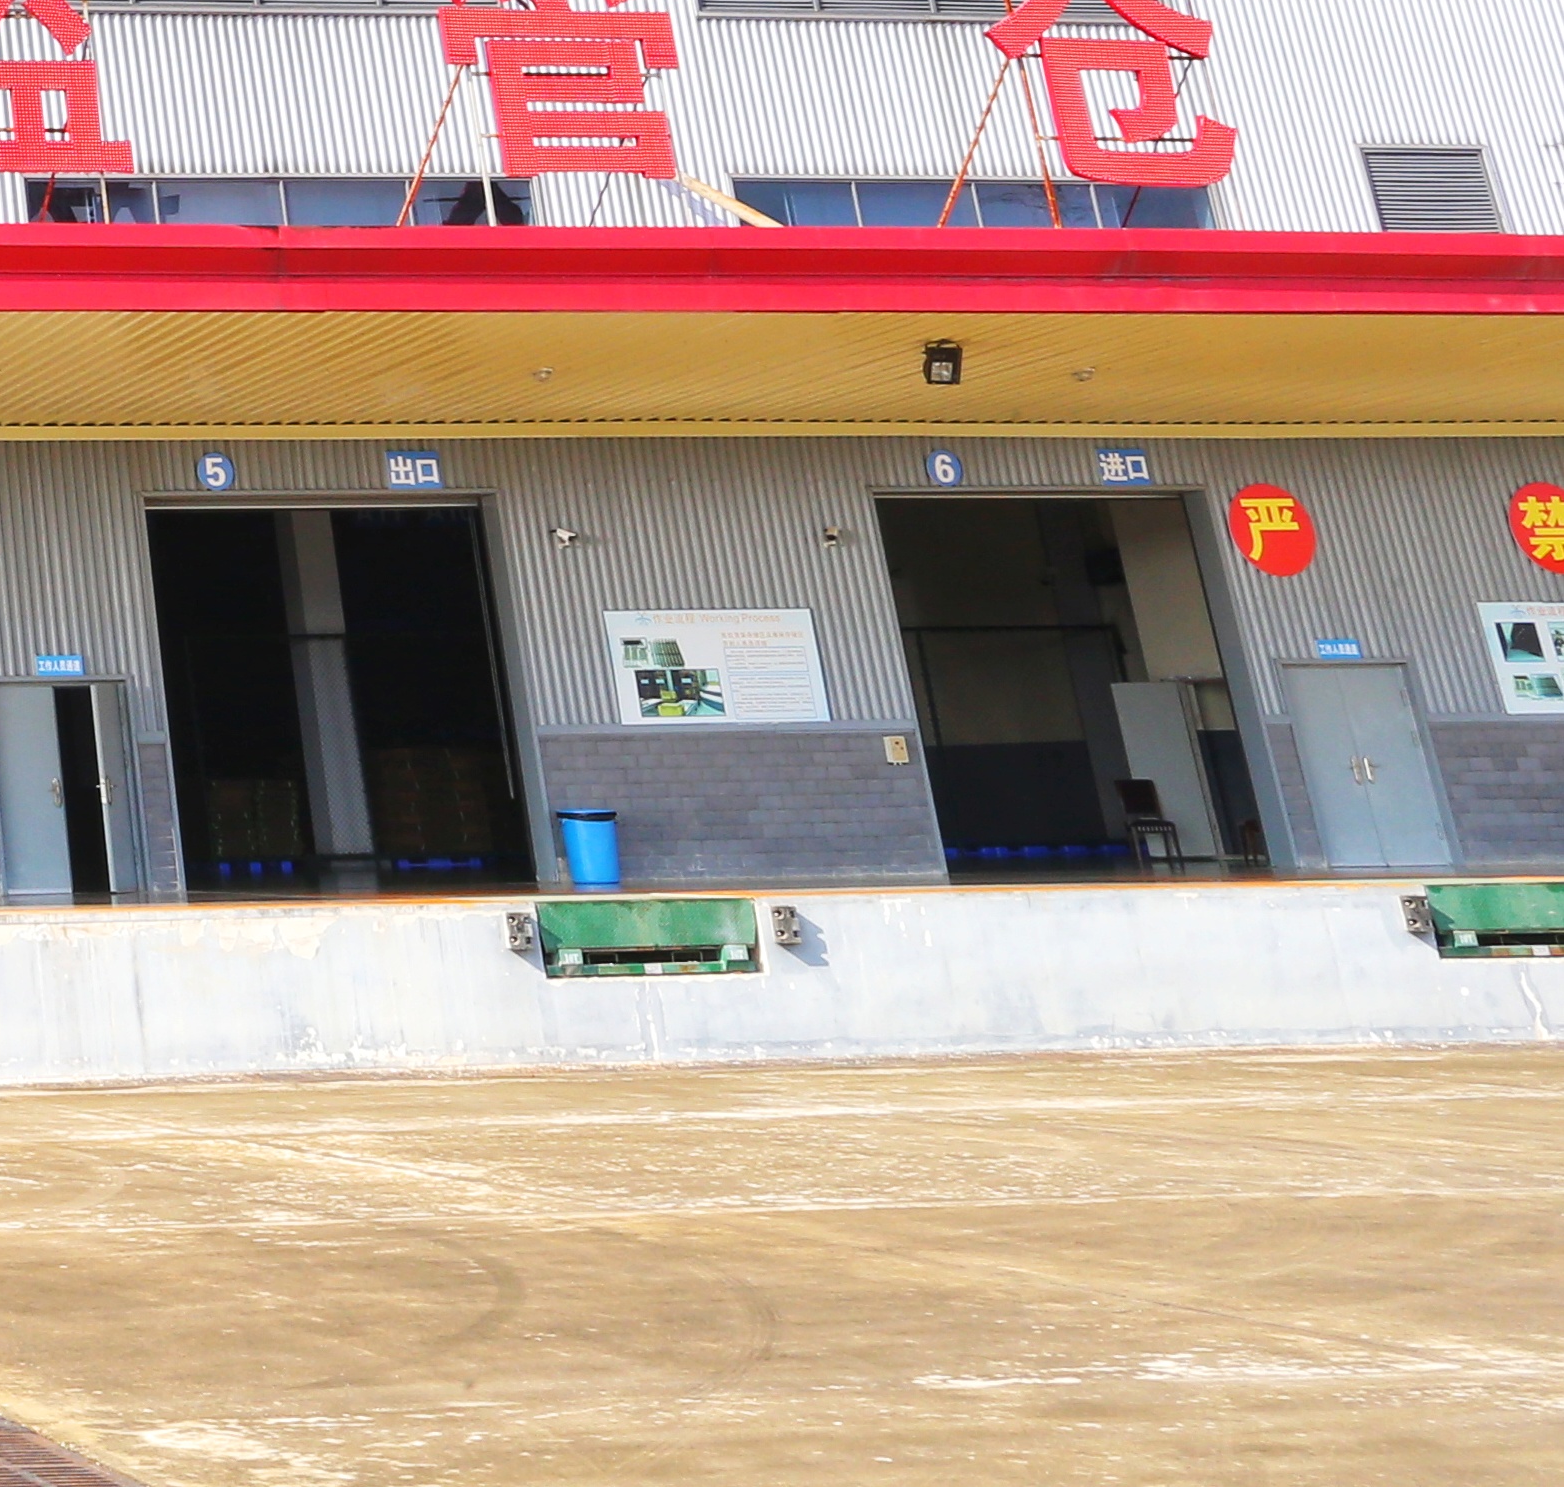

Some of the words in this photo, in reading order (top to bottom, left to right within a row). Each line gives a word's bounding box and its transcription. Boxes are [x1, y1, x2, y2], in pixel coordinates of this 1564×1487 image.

[205, 457, 227, 487] 5
[389, 455, 440, 487] 出口
[933, 454, 956, 484] 6
[1099, 452, 1149, 482] 进口
[1239, 497, 1300, 562] 严
[701, 613, 740, 624] Working
[741, 613, 781, 623] Process
[38, 659, 81, 672] 工作人员通道
